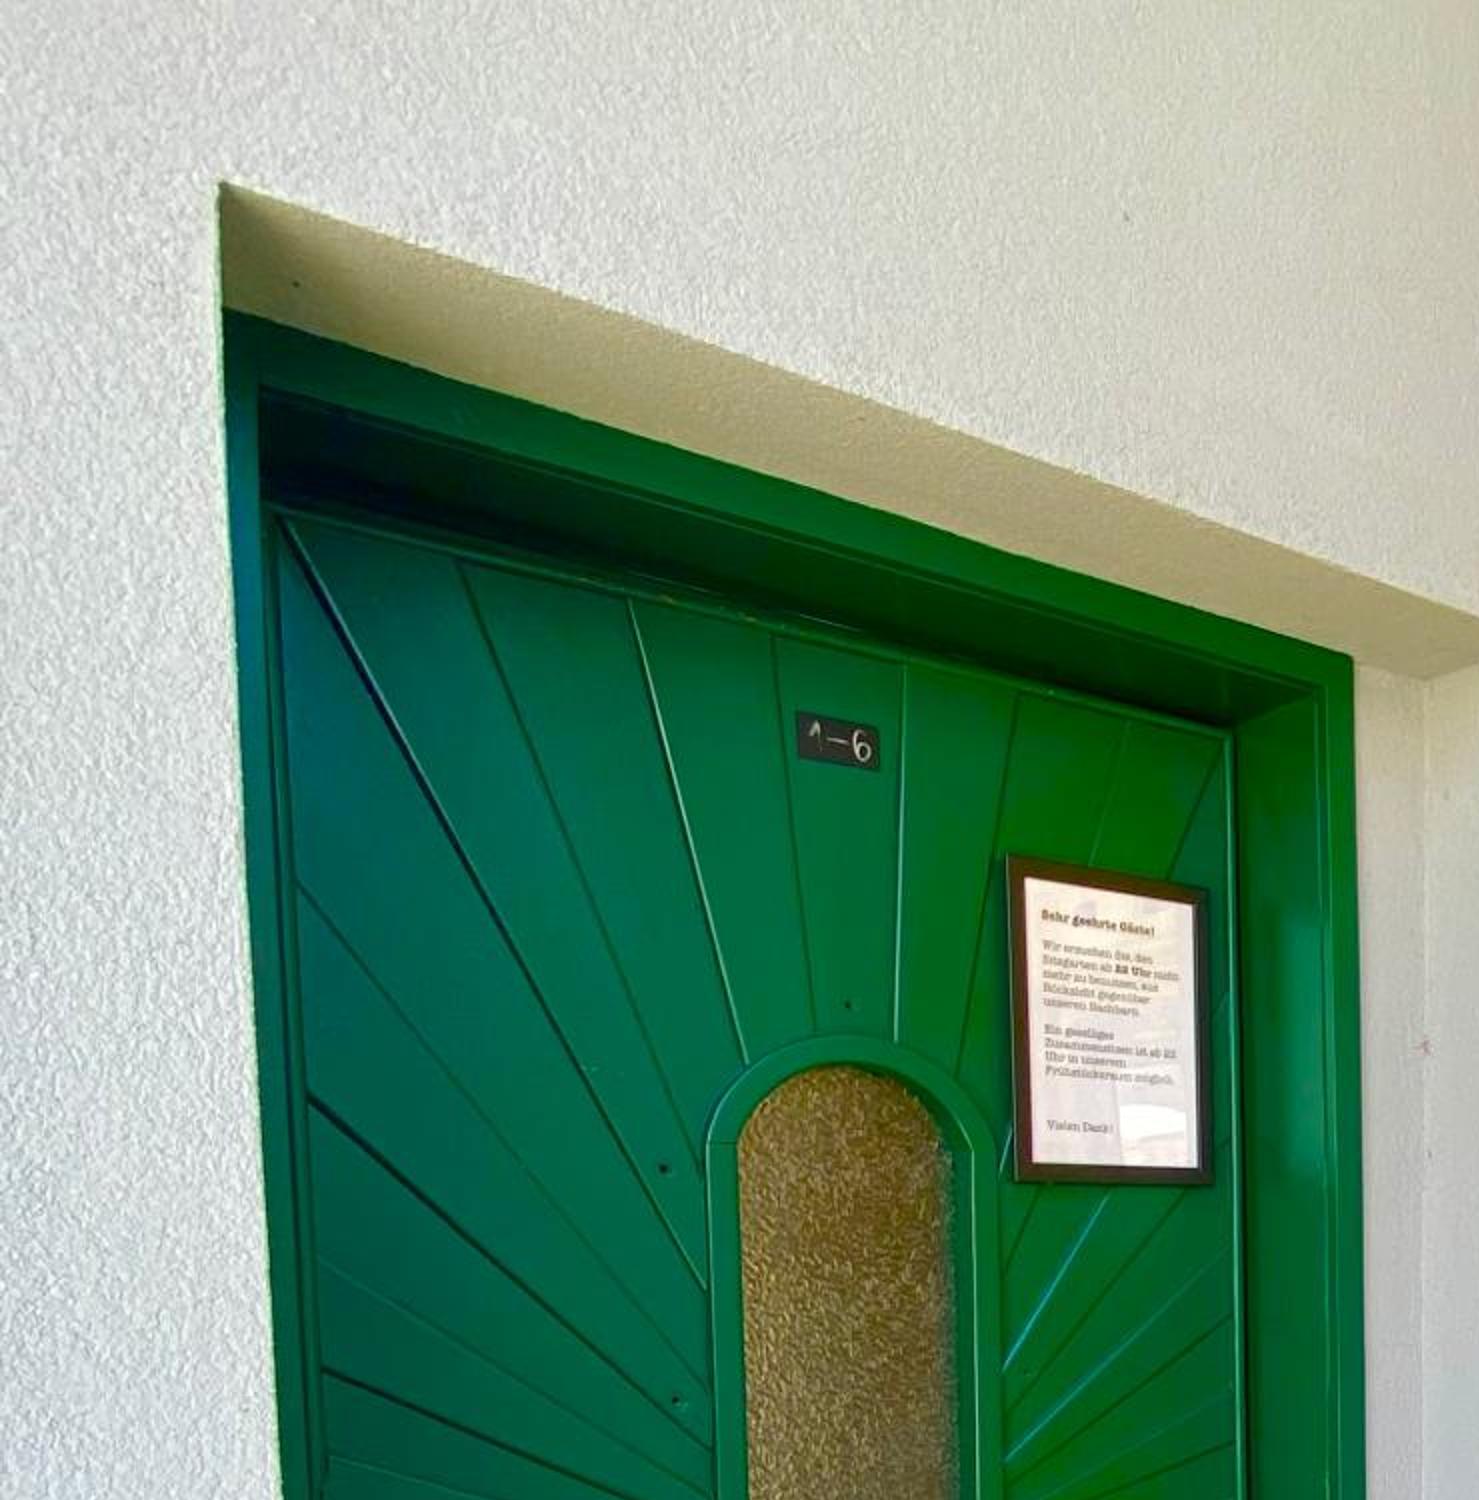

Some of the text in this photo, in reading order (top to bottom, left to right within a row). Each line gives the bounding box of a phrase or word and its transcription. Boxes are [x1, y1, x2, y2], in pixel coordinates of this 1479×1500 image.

[1041, 909, 1070, 923] Sehr
[1072, 916, 1117, 931] geehrte
[1131, 966, 1152, 978] Uhr
